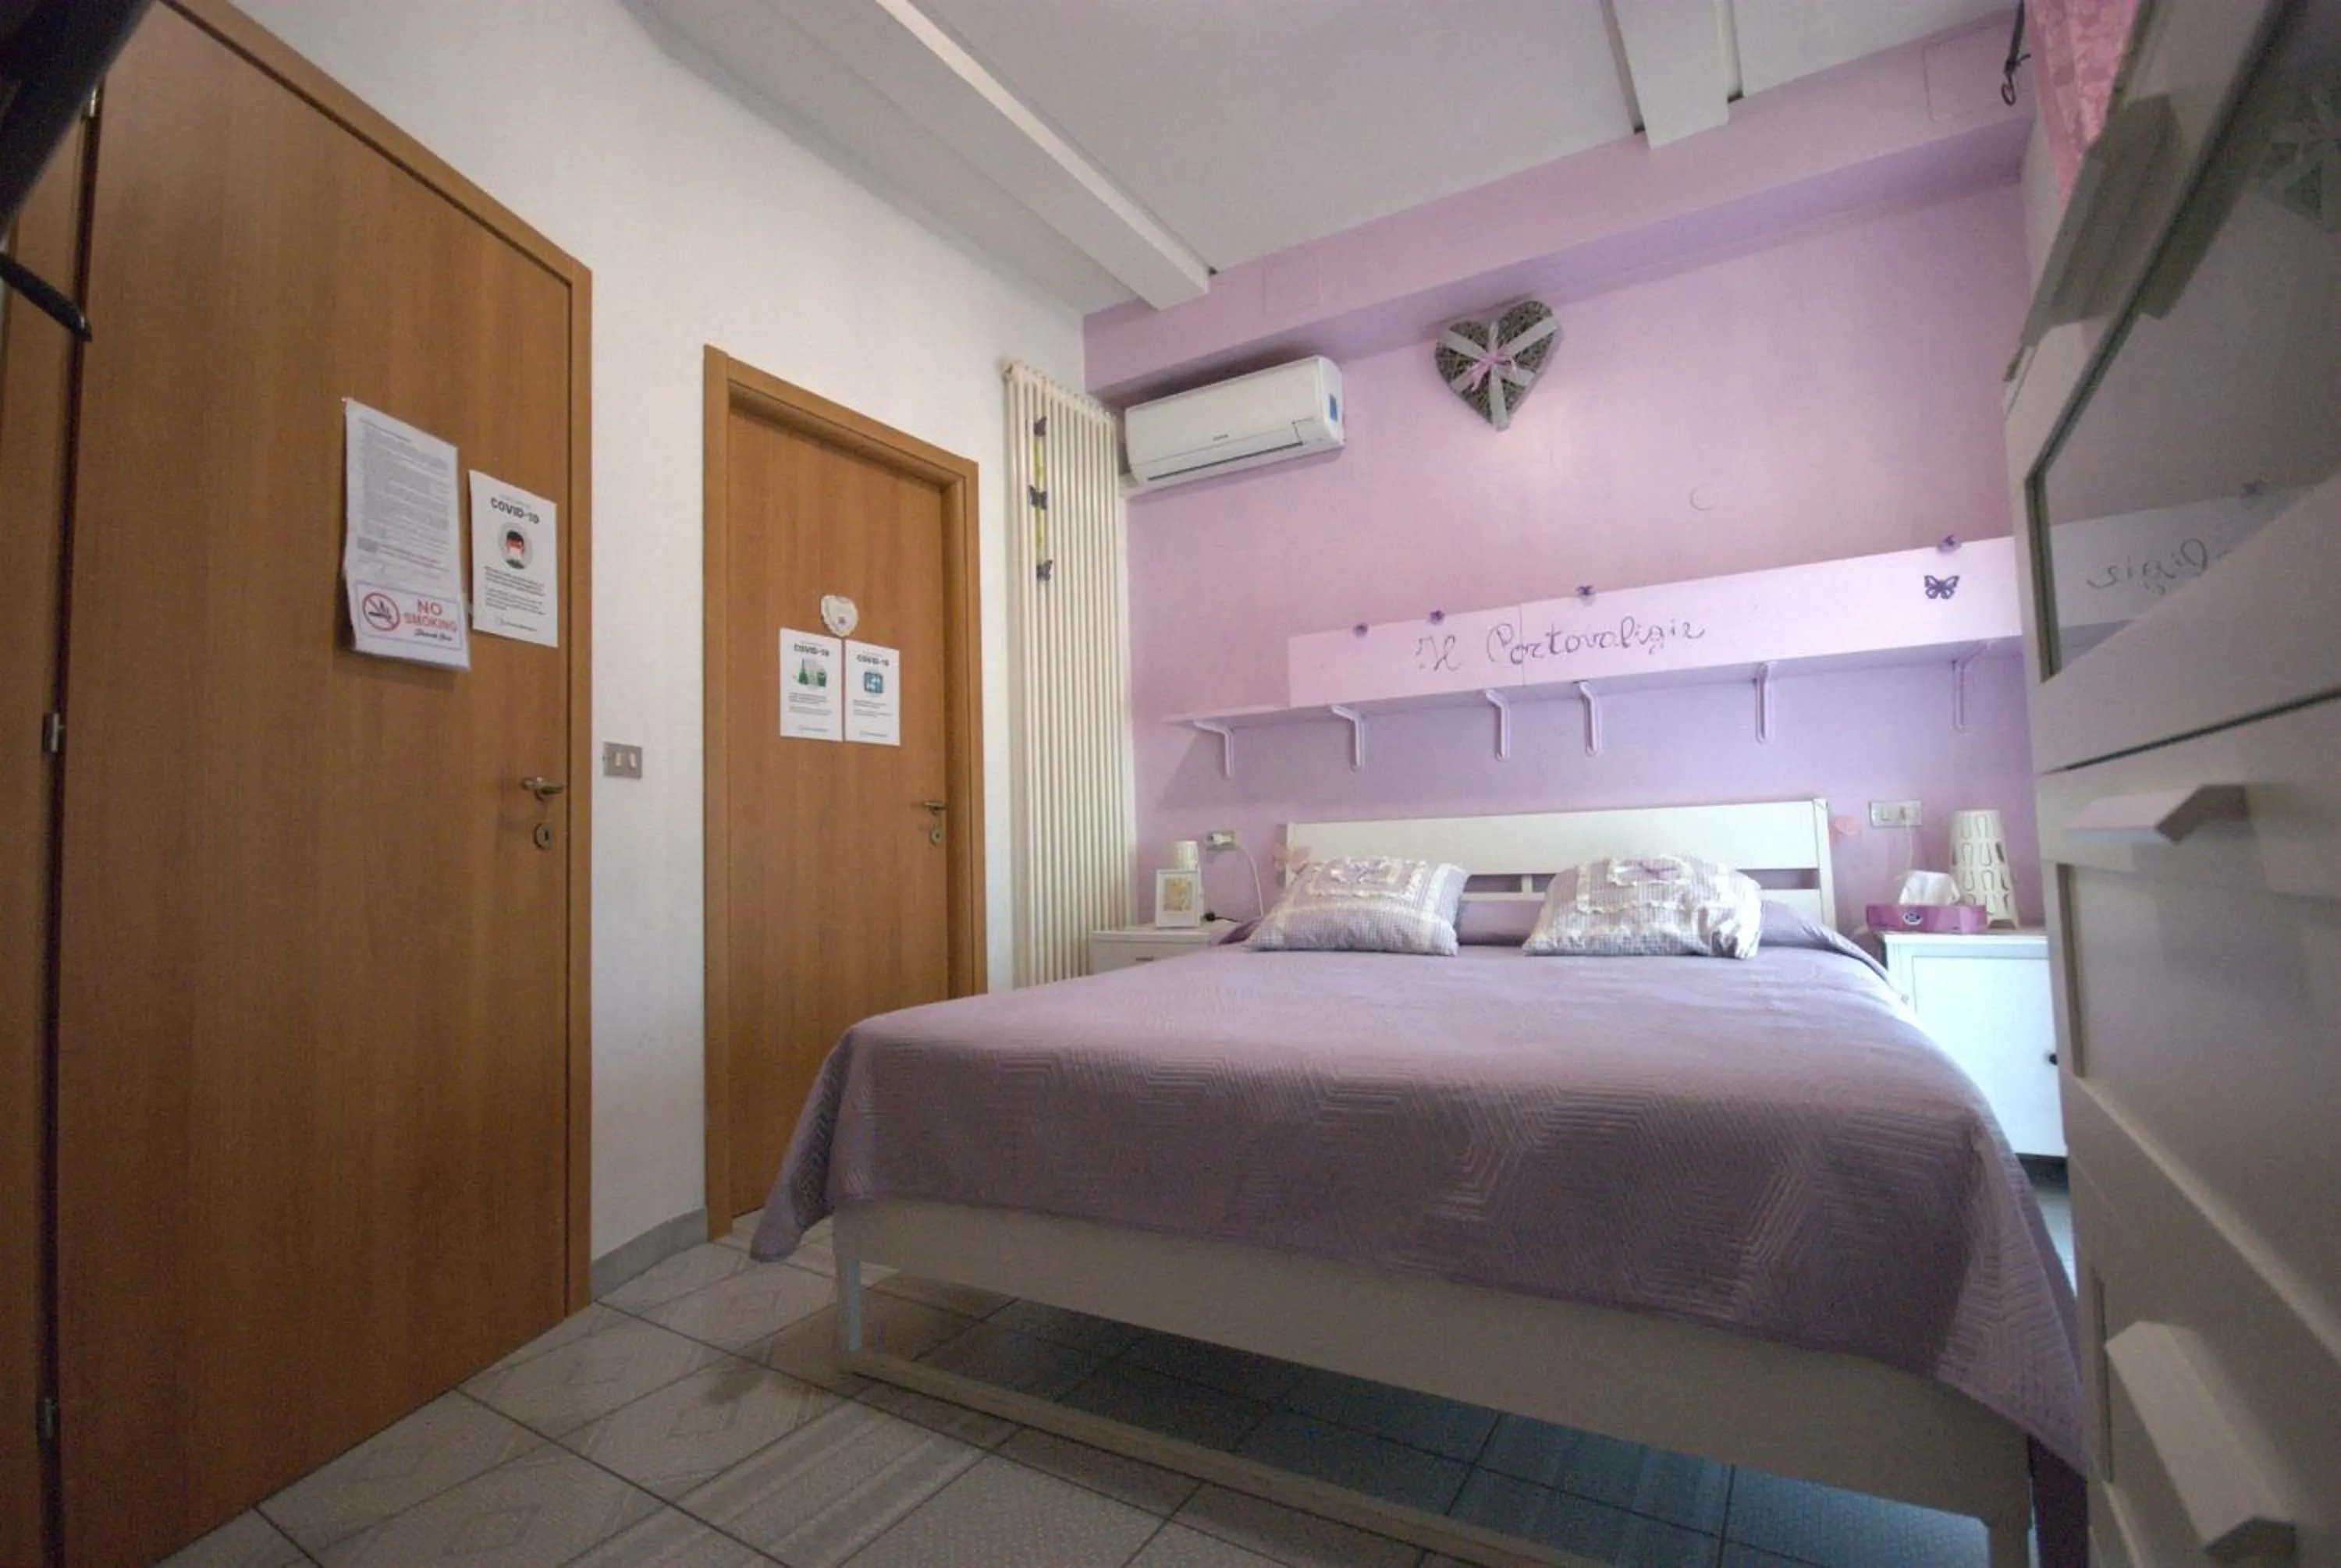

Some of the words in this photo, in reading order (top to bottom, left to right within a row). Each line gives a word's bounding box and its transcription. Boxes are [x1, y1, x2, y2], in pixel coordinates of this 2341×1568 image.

[490, 497, 540, 524] COVID-19
[417, 598, 443, 616] NO
[403, 612, 457, 632] SMOKING
[794, 644, 829, 657] COVID-19
